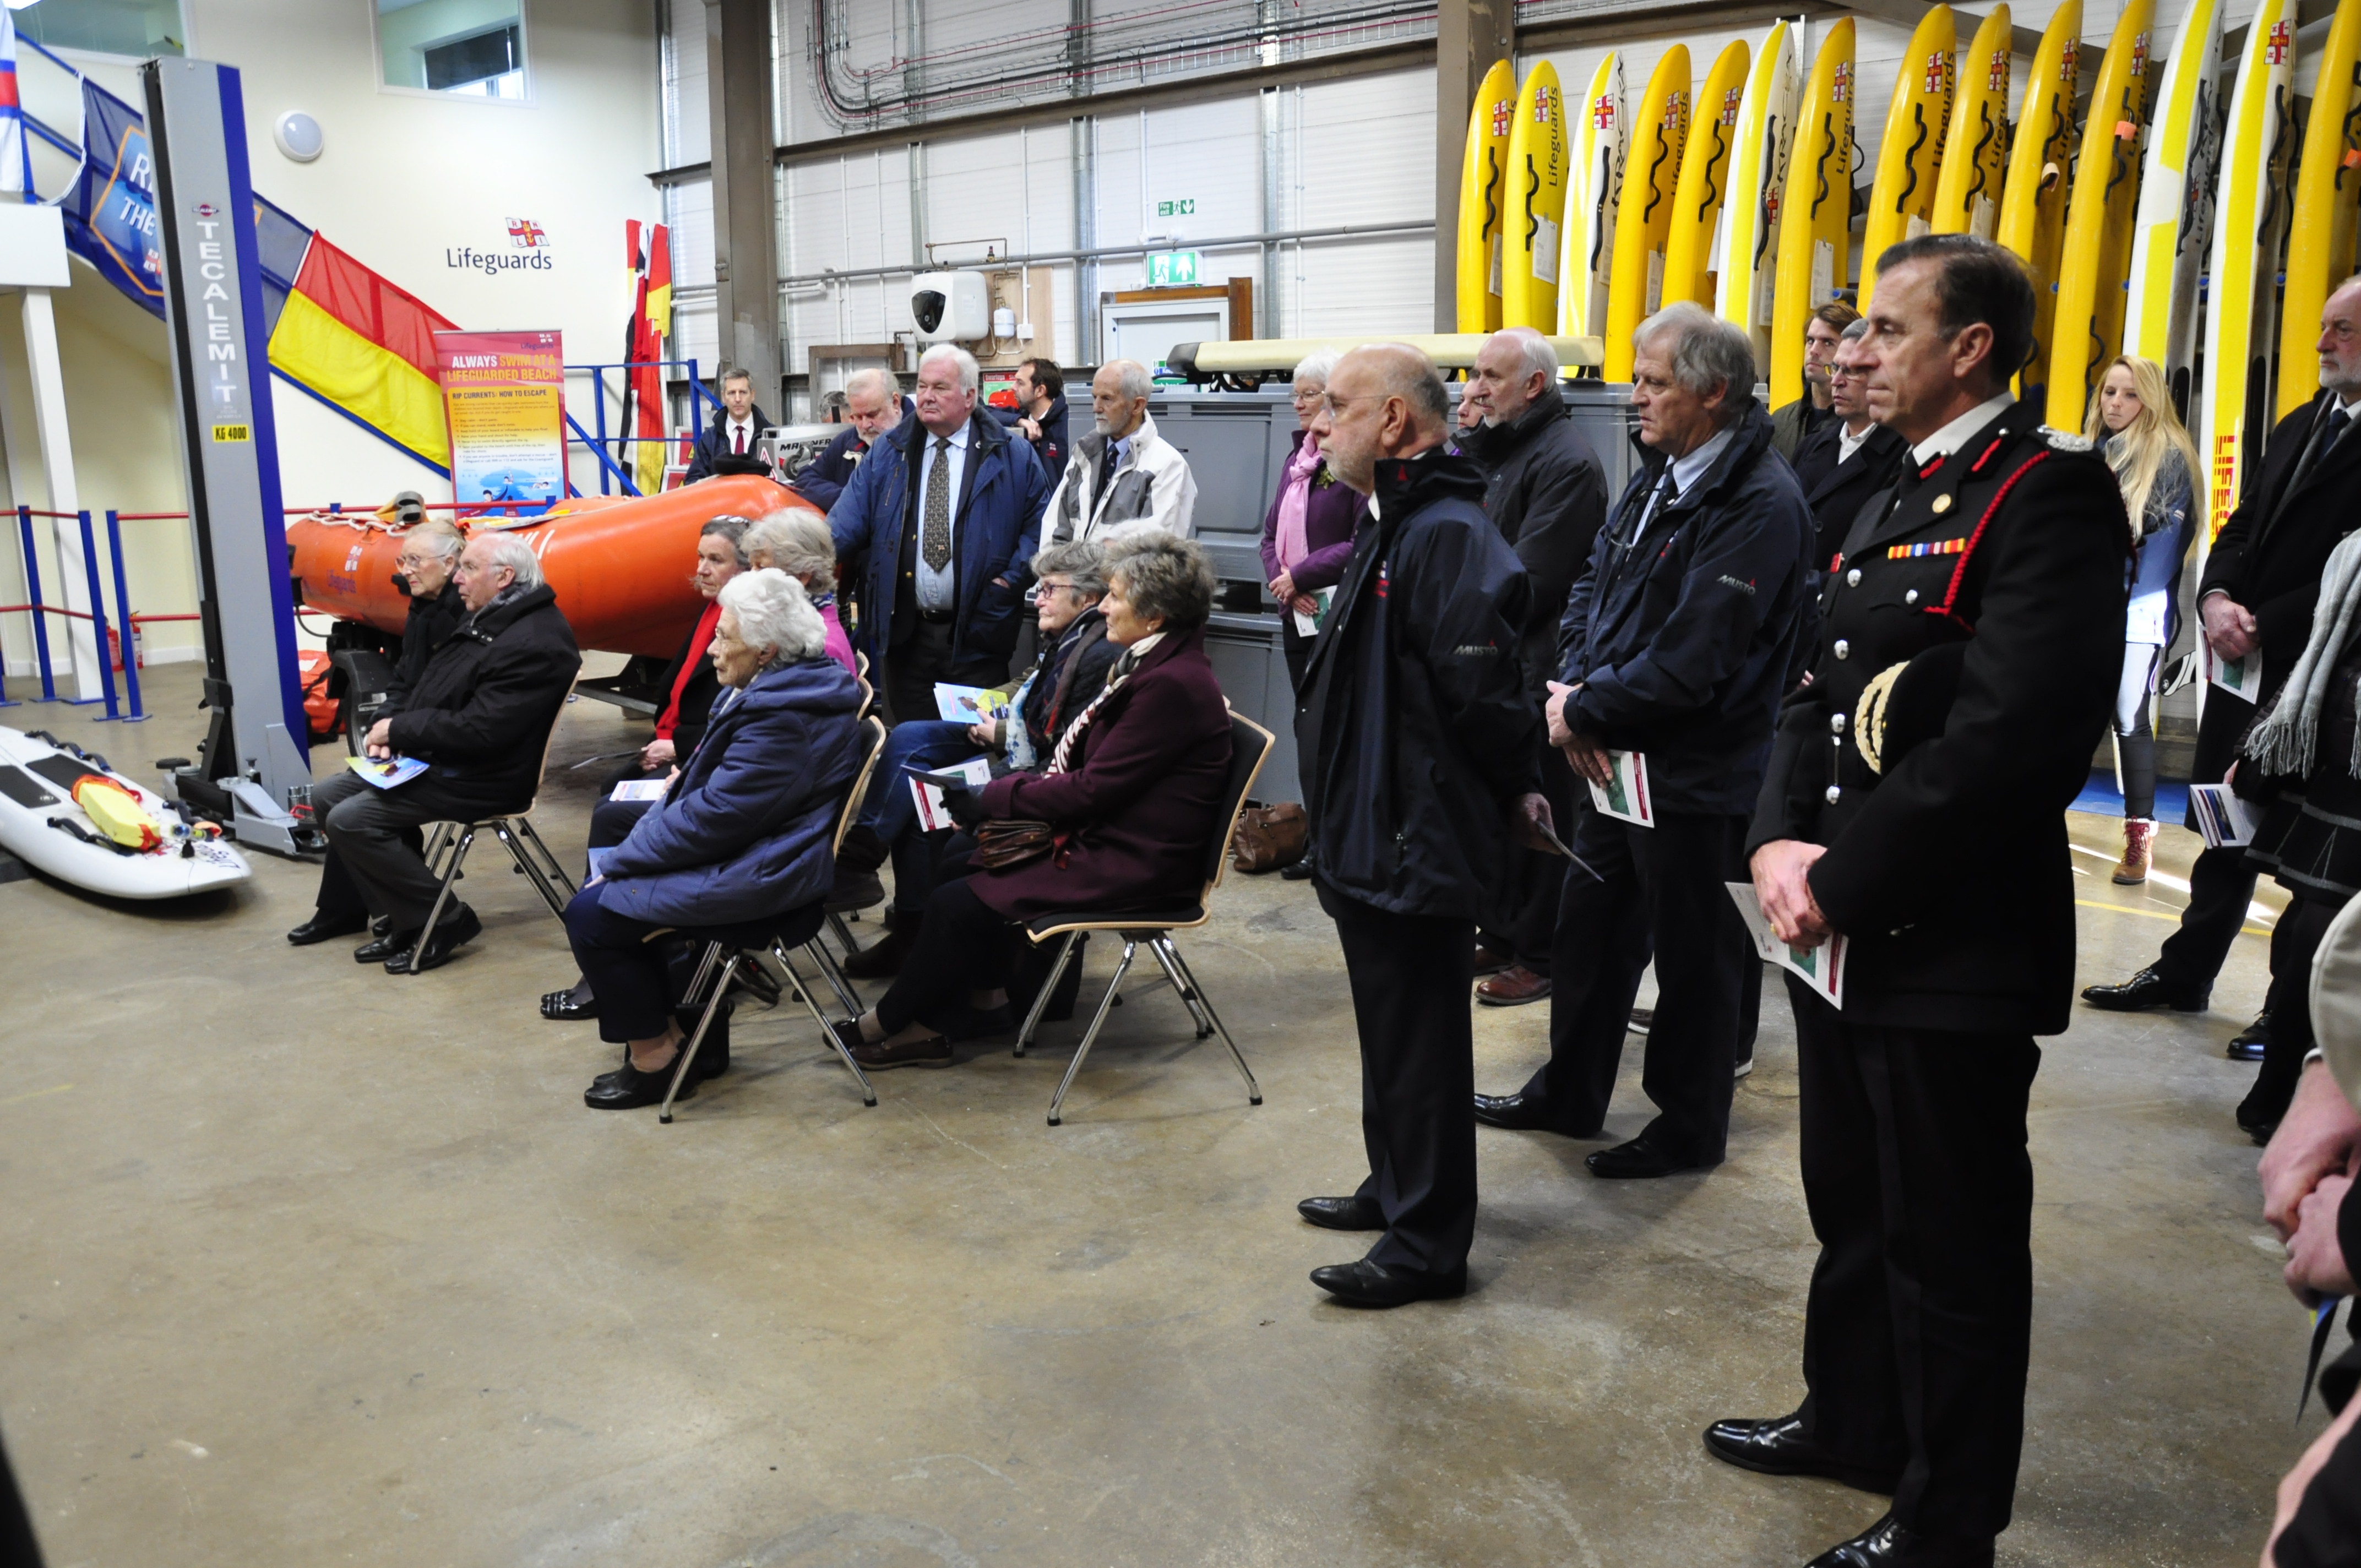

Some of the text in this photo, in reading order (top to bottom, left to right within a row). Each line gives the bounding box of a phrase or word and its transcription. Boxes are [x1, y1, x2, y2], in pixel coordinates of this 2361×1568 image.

[1836, 62, 1855, 175] Lifeguards
[1548, 86, 1560, 187] Lifeguards
[447, 248, 552, 275] Lifeguards
[196, 221, 237, 402] TECALEMIT
[452, 354, 556, 368] ALWAYS SWIM AT A
[447, 368, 557, 382] LIFEGUARDED BEACH
[215, 427, 247, 440] KG 4000
[1716, 574, 1756, 595] MUSTO
[1453, 644, 1498, 656] MUSTO
